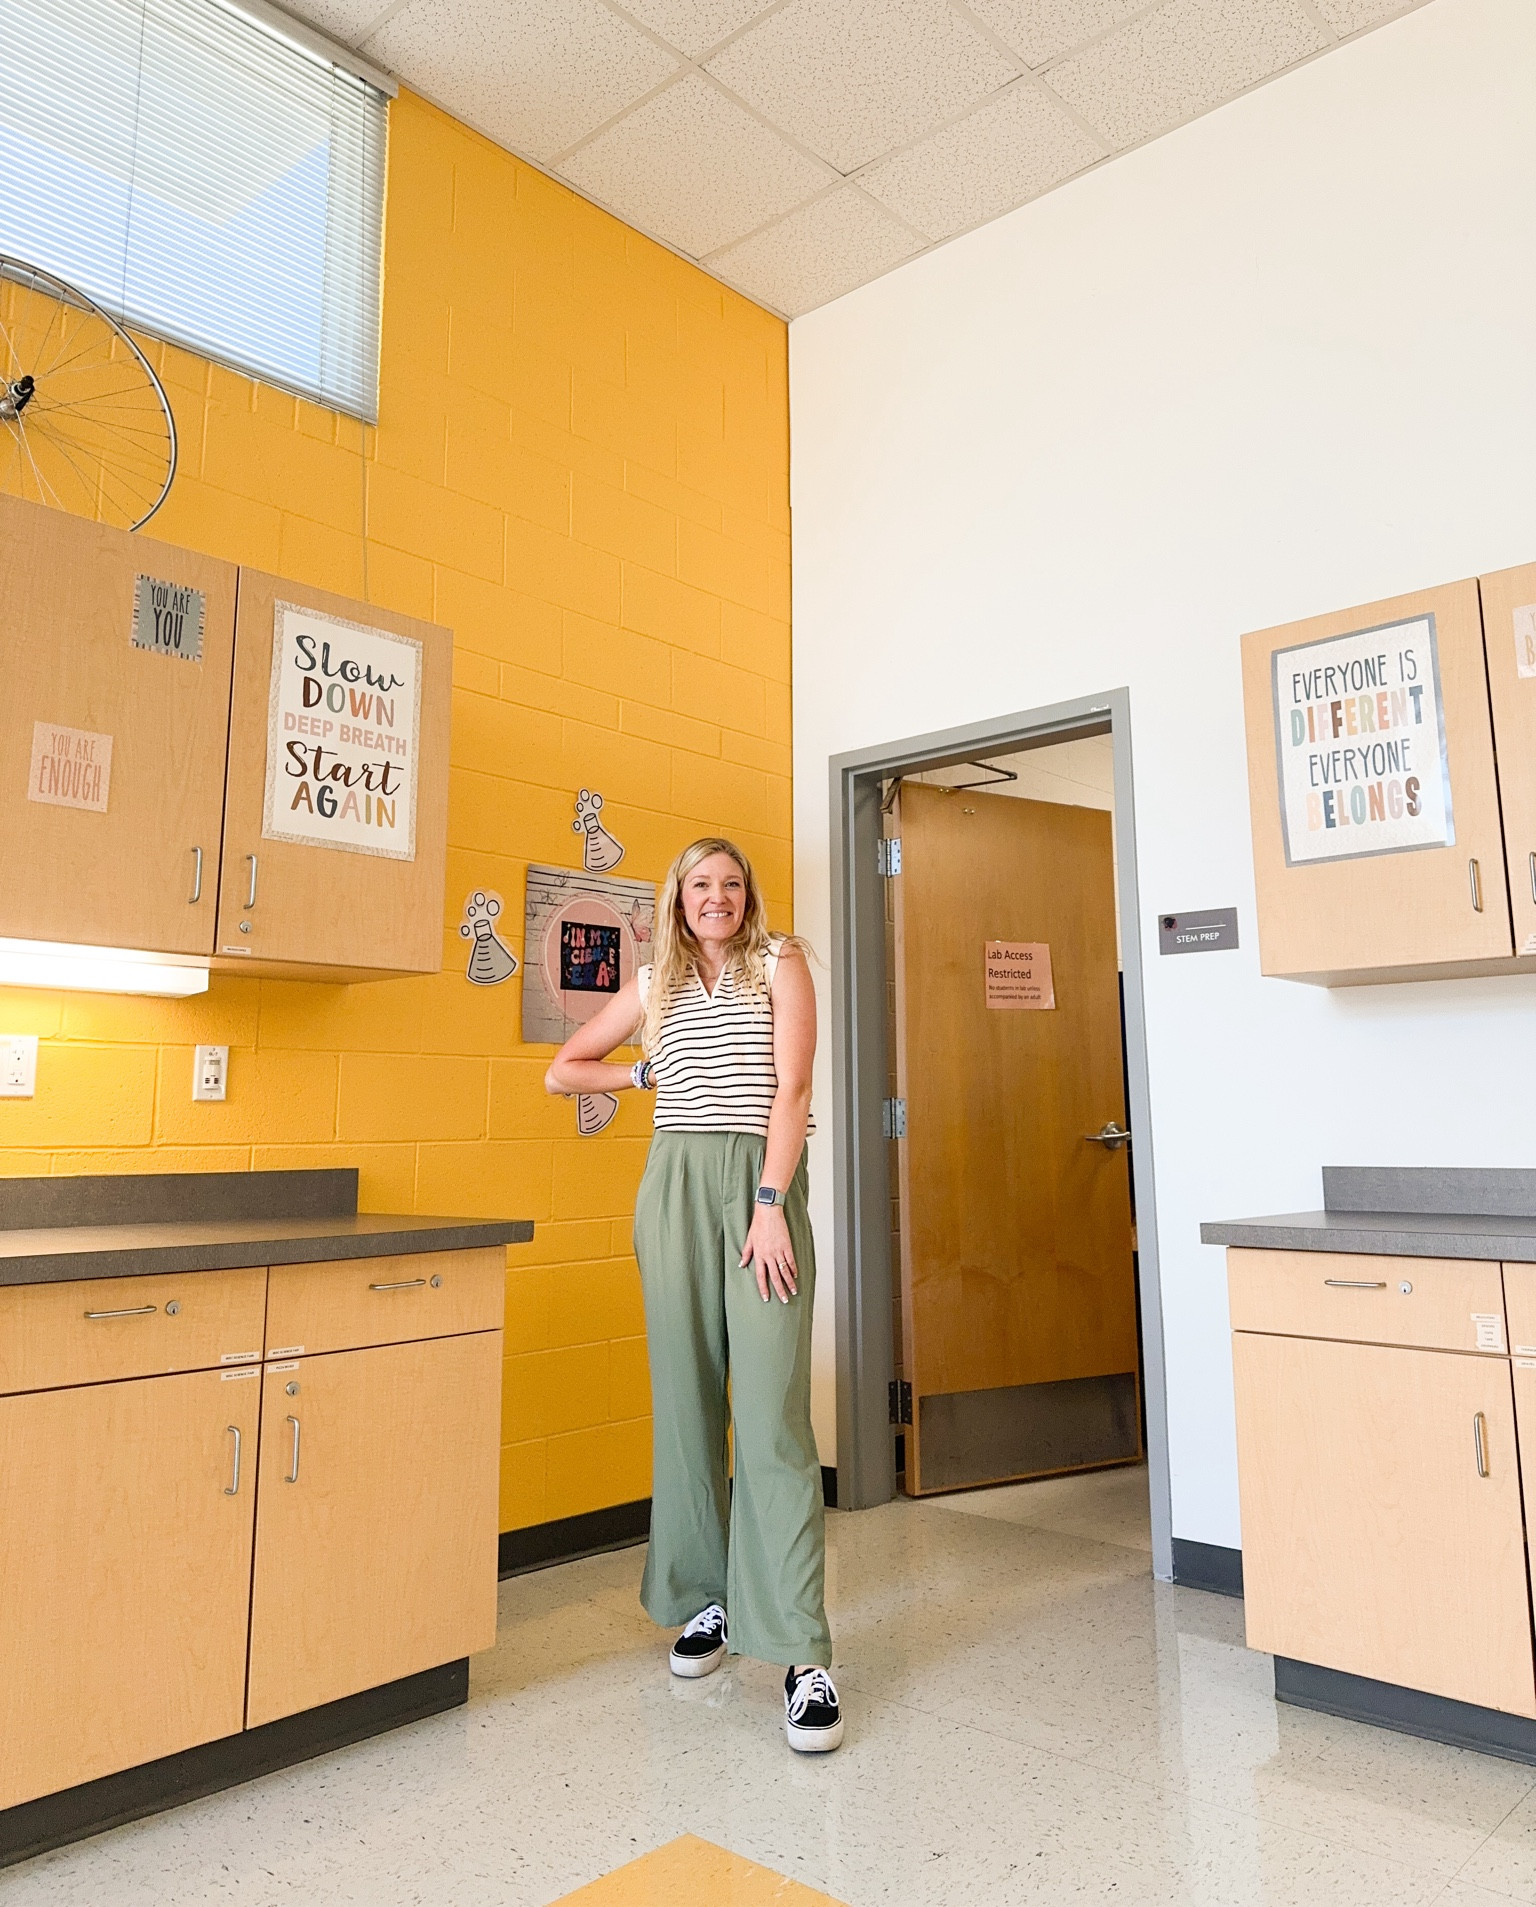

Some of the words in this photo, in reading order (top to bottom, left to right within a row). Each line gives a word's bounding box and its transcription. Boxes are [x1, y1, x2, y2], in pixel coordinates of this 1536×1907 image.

[151, 585, 169, 608] YOU
[172, 591, 191, 615] ARE
[153, 608, 184, 649] YOU
[294, 634, 405, 692] Slow
[1292, 654, 1388, 703] EVERYONE
[1399, 649, 1417, 682] IS
[302, 676, 395, 727] DOWN
[1290, 685, 1424, 747] DIFFERENT
[51, 733, 71, 757] YOU
[75, 738, 96, 762] ARE
[284, 712, 334, 738] DEEP
[339, 723, 407, 757] BREATH
[38, 754, 102, 803] ENOUGH
[285, 741, 405, 796] Start
[1309, 738, 1411, 787] EVERYONE
[290, 781, 396, 829] AGAIN
[1306, 776, 1422, 832] BELONGS
[571, 927, 586, 948] IN
[589, 929, 610, 946] MY
[988, 949, 1002, 960] Lab
[1004, 950, 1033, 961] Access
[1176, 934, 1198, 943] STEM
[1200, 932, 1220, 941] PREP
[571, 961, 610, 987] ERA
[988, 968, 1032, 979] Restricted
